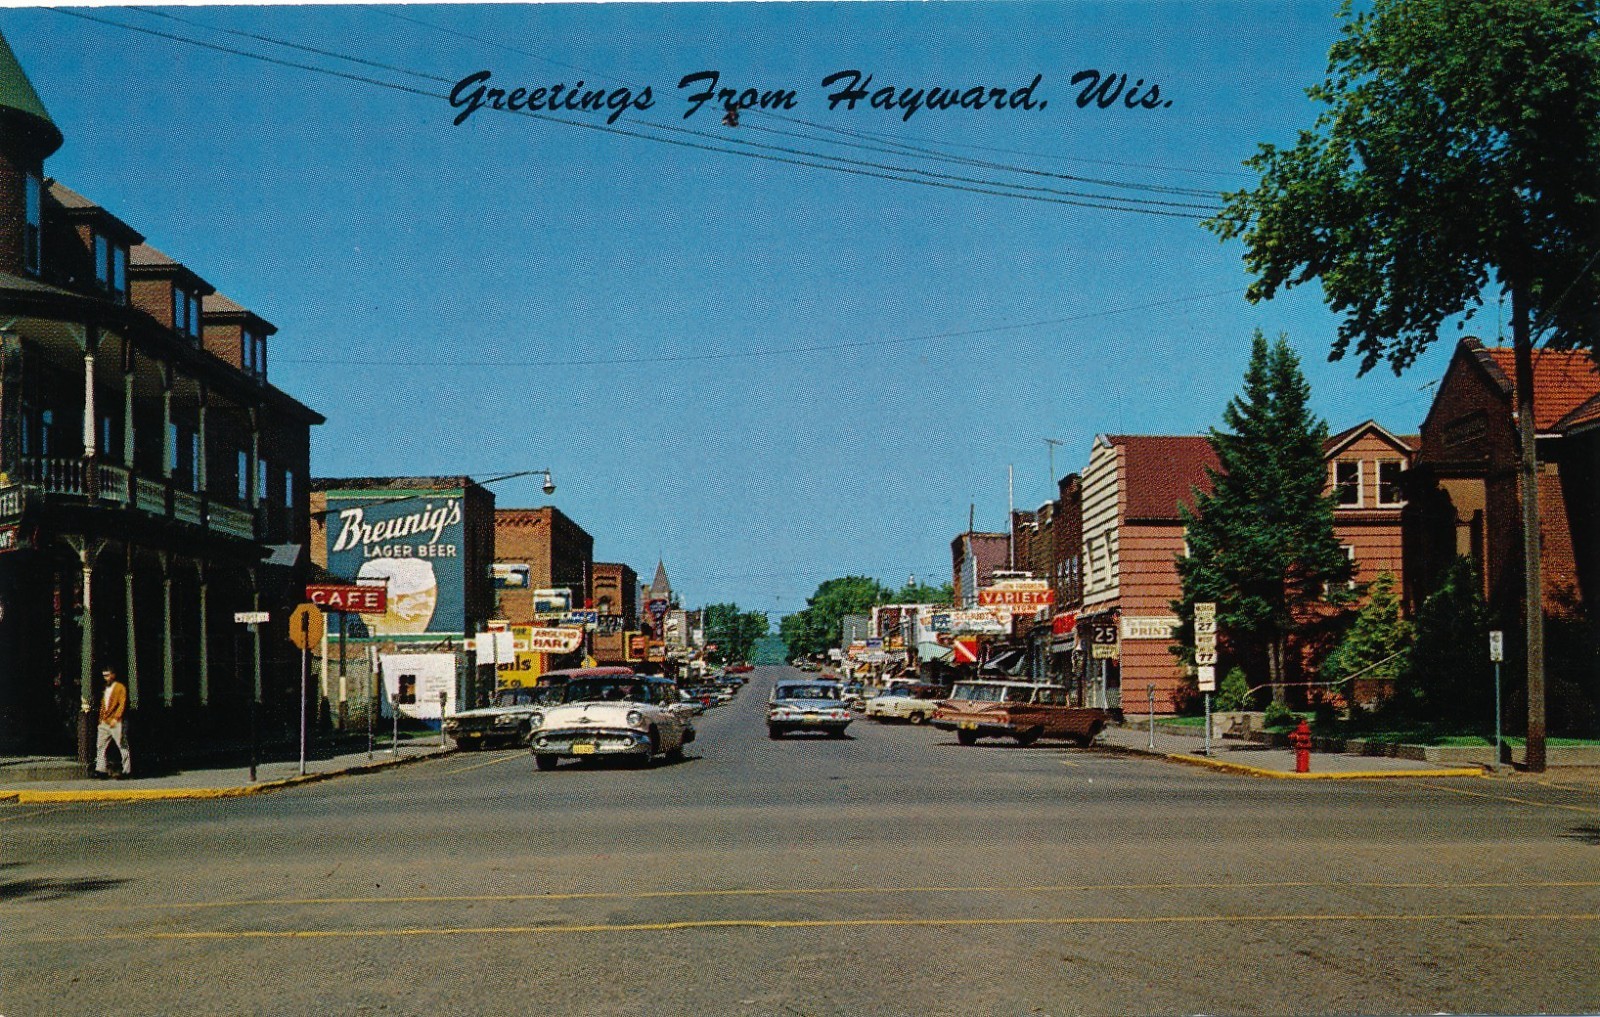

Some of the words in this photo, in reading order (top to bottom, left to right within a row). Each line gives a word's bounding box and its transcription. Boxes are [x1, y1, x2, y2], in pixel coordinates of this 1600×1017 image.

[333, 499, 461, 551] Breunig's
[364, 545, 413, 557] LAGER
[418, 544, 457, 557] BEER
[311, 591, 380, 608] CAFE
[983, 590, 1050, 603] VARIETY
[1198, 622, 1212, 631] 27
[1094, 627, 1114, 642] 25
[533, 638, 562, 648] BAR
[1199, 653, 1213, 662] 77
